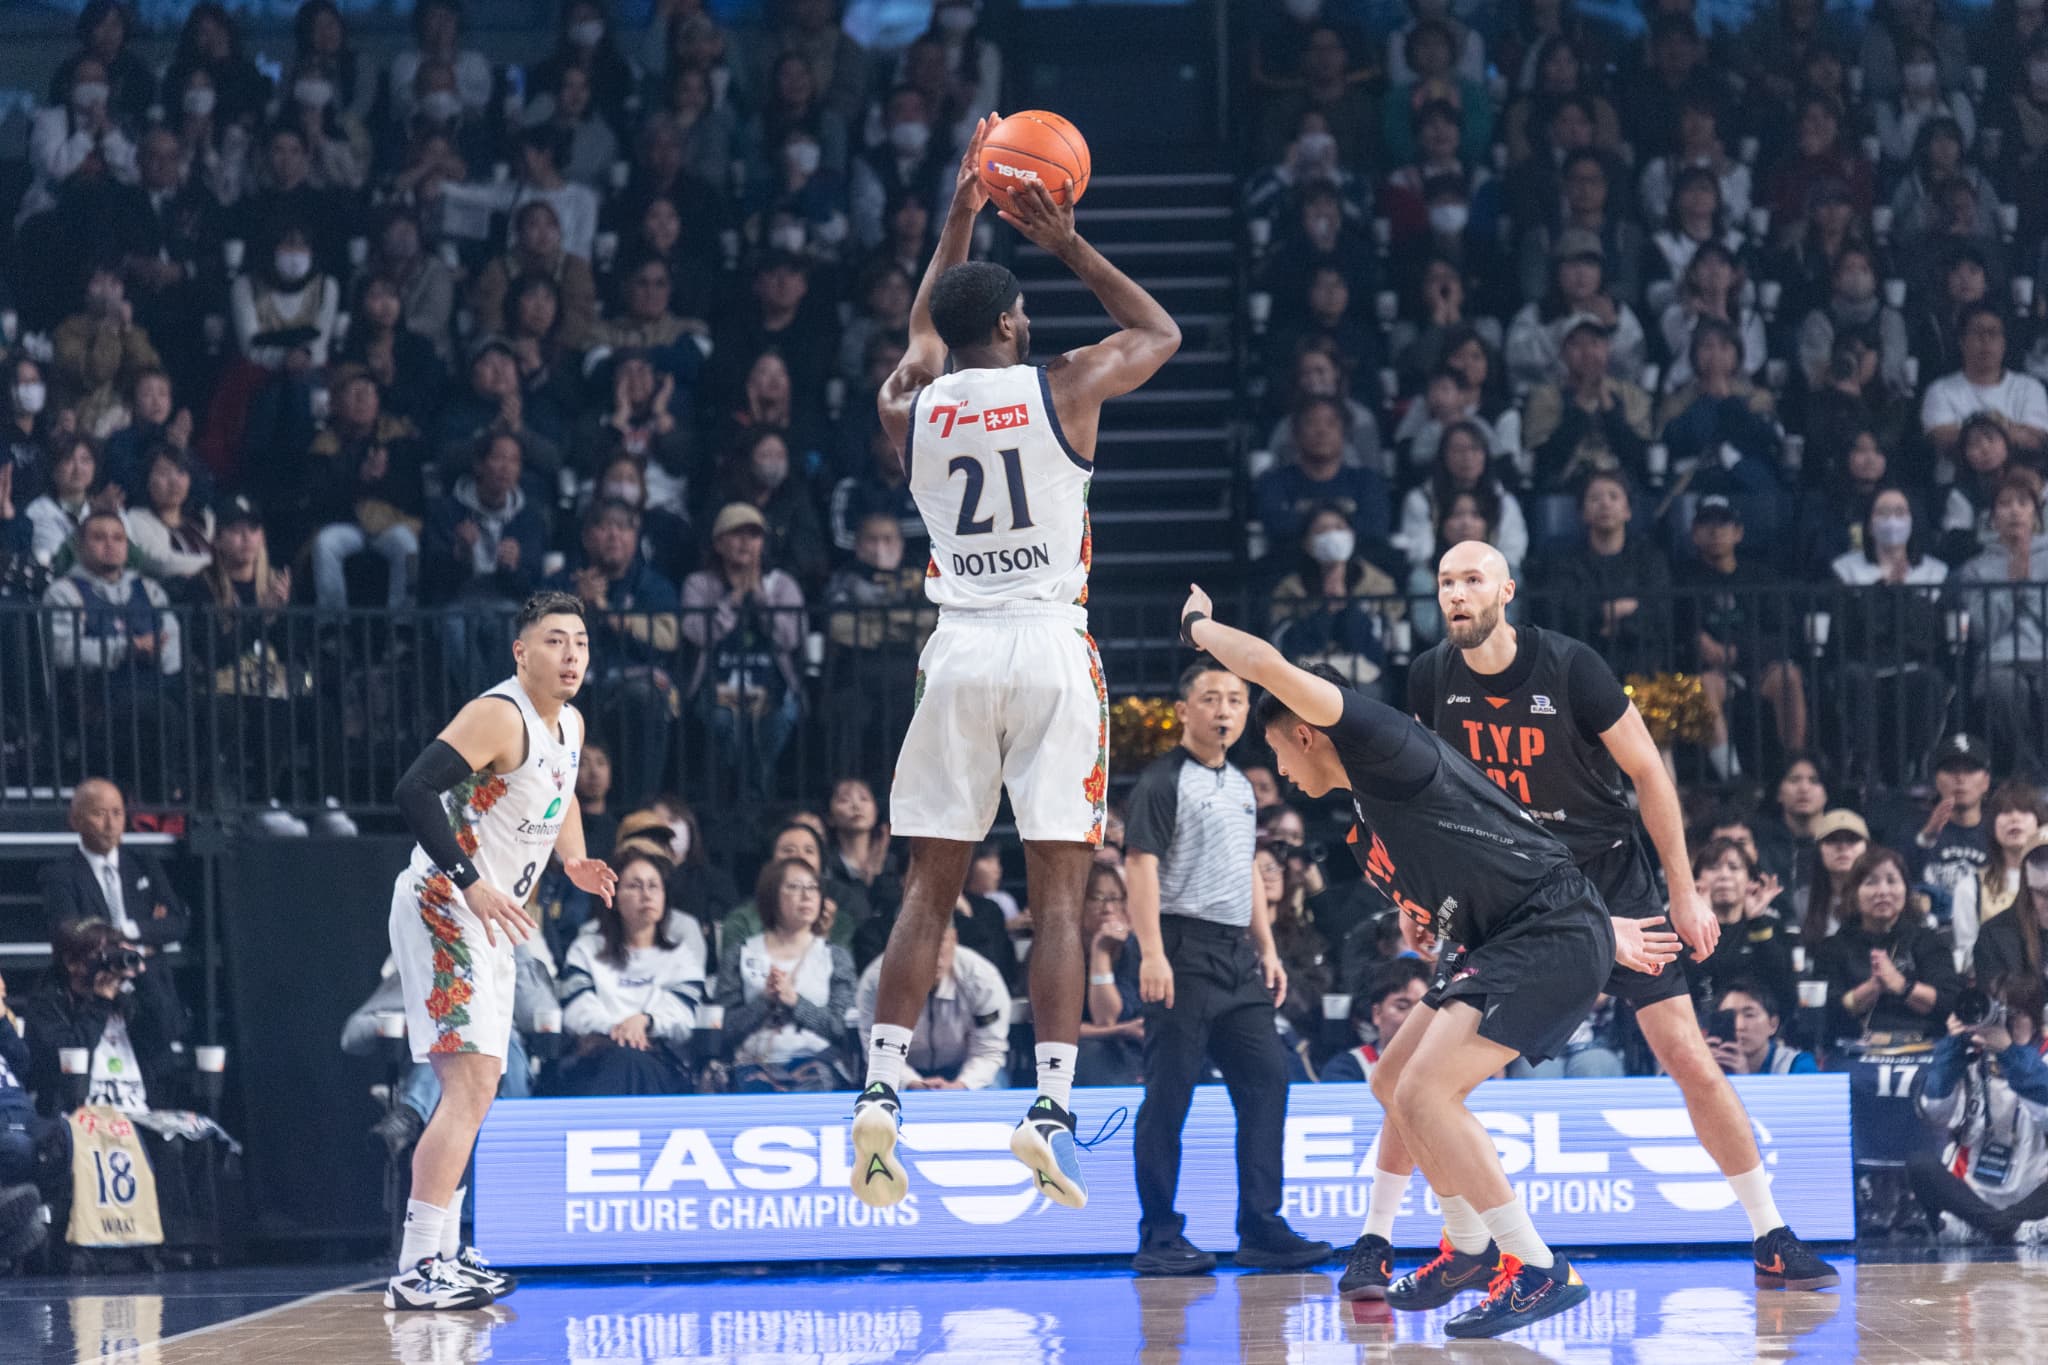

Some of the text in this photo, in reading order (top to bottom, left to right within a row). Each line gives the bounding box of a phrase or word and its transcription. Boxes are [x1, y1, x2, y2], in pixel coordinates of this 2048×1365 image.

[928, 400, 1030, 438] グーネット
[948, 448, 1035, 536] 21
[952, 543, 1050, 576] DOTSON
[1462, 720, 1545, 766] T.Y.P
[1438, 820, 1474, 834] NEVER
[1499, 836, 1514, 845] UP
[513, 861, 537, 897] 8
[1876, 1064, 1920, 1098] 17
[1283, 1112, 1609, 1178] ESL
[91, 1150, 137, 1205] 18
[566, 1193, 921, 1233] FUTURE CHAMPIONS
[1281, 1179, 1635, 1218] FUTUE CPIONS
